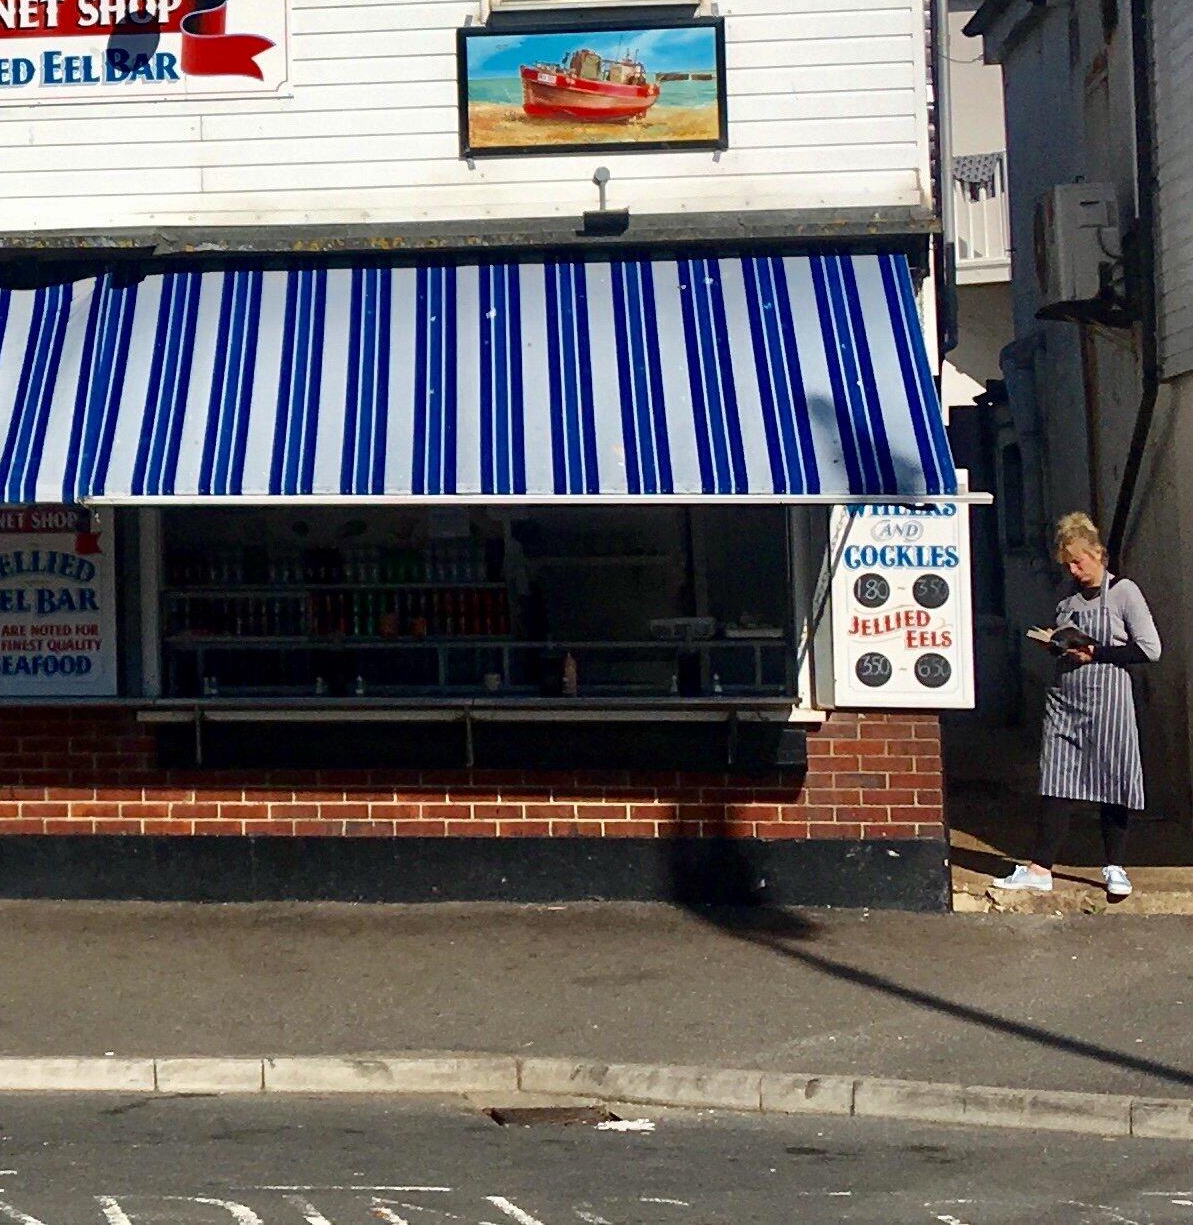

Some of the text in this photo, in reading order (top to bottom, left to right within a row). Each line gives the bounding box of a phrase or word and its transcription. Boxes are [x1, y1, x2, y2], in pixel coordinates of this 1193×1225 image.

[41, 51, 101, 84] EEL
[104, 48, 181, 82] BAR
[30, 510, 78, 529] SHOP
[844, 545, 960, 569] COCKLES
[858, 578, 889, 599] 180
[37, 588, 99, 614] BAR
[1, 625, 26, 636] ARE
[31, 624, 72, 636] NOTED
[75, 623, 99, 635] FOR
[848, 609, 931, 636] JELLIED
[1, 639, 43, 651] FINEST
[47, 638, 102, 652] QUALITY
[906, 629, 952, 649] EELS
